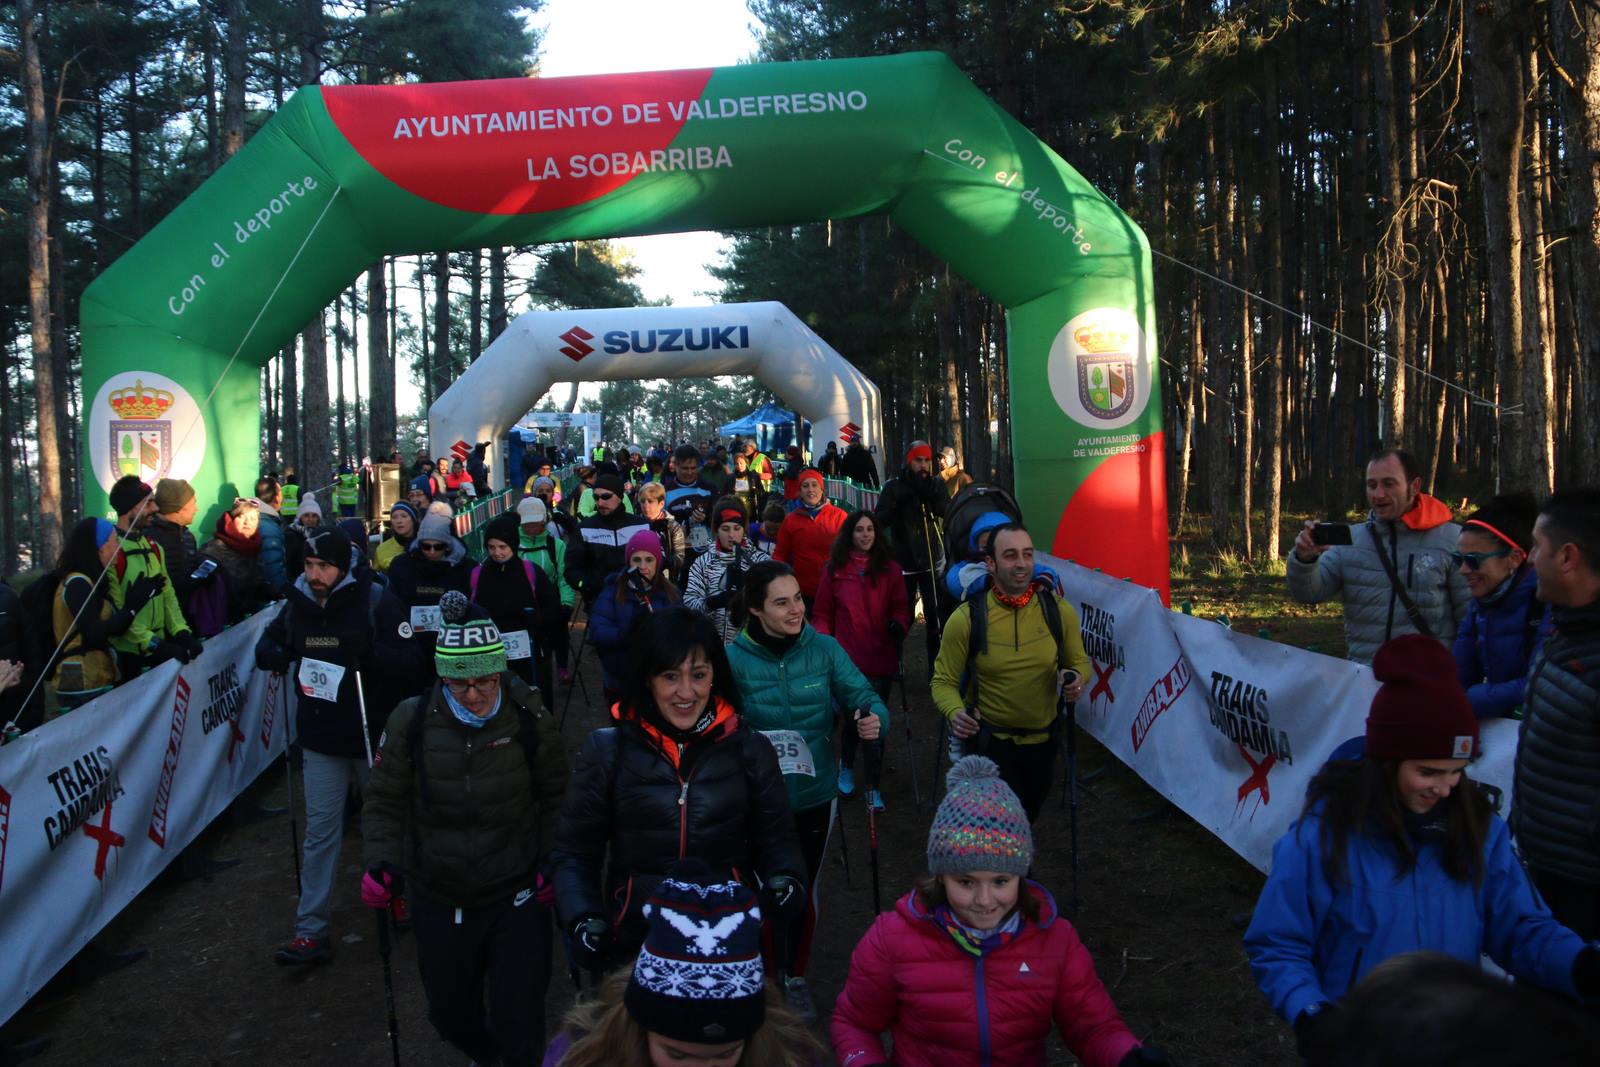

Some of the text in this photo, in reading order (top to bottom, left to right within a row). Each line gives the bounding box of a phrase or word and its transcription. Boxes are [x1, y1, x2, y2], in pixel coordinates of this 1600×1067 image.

[393, 90, 867, 139] AYUNTAMIENTO DE VALDEFRESNO
[527, 145, 733, 181] LA SOBARRIBA
[944, 139, 1092, 256] Con el deporte
[168, 176, 318, 315] Con el deporte
[603, 325, 749, 354] SUZUKI
[1073, 444, 1146, 457] DE VALDEFRESNO
[1077, 433, 1142, 446] AYUNTAMIENTO
[421, 613, 434, 623] 31
[1081, 602, 1115, 641] TRANS
[207, 662, 240, 703] TRANS
[311, 671, 327, 685] 30
[1211, 671, 1271, 724] TRANS
[774, 742, 799, 758] 85
[47, 745, 114, 806] TRANS
